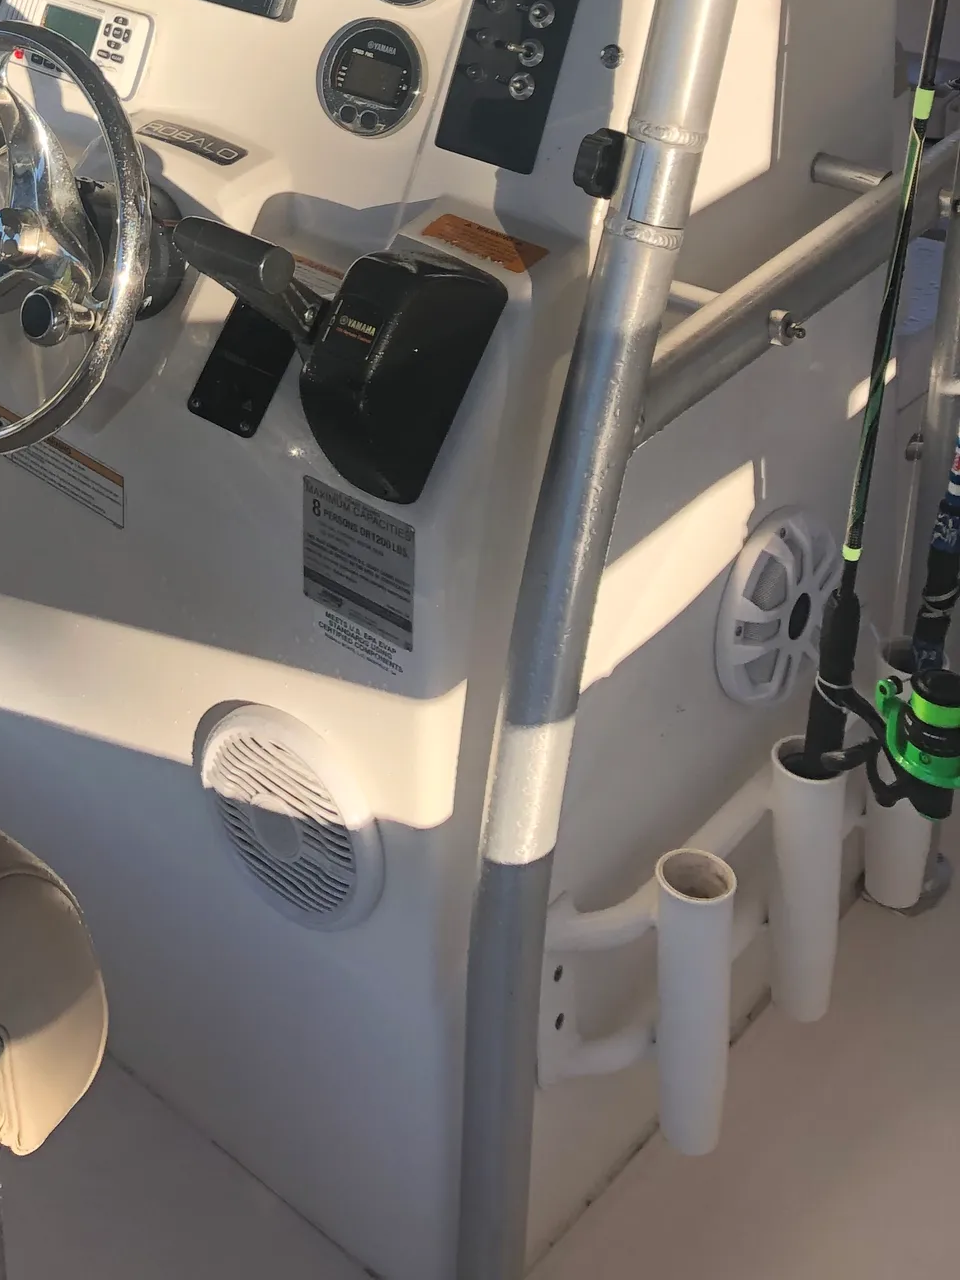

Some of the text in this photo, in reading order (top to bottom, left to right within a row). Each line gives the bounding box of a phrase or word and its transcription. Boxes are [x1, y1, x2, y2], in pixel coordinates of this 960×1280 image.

[374, 42, 397, 56] YAMAHA
[143, 122, 239, 160] ROBALO
[347, 318, 376, 337] YAMAHA
[303, 480, 350, 512] MAXIMUM
[353, 505, 412, 542] CAPACITIES
[312, 498, 321, 517] 8
[323, 508, 358, 533] PERSONS
[371, 532, 391, 549] 1200
[325, 611, 348, 628] MEETS
